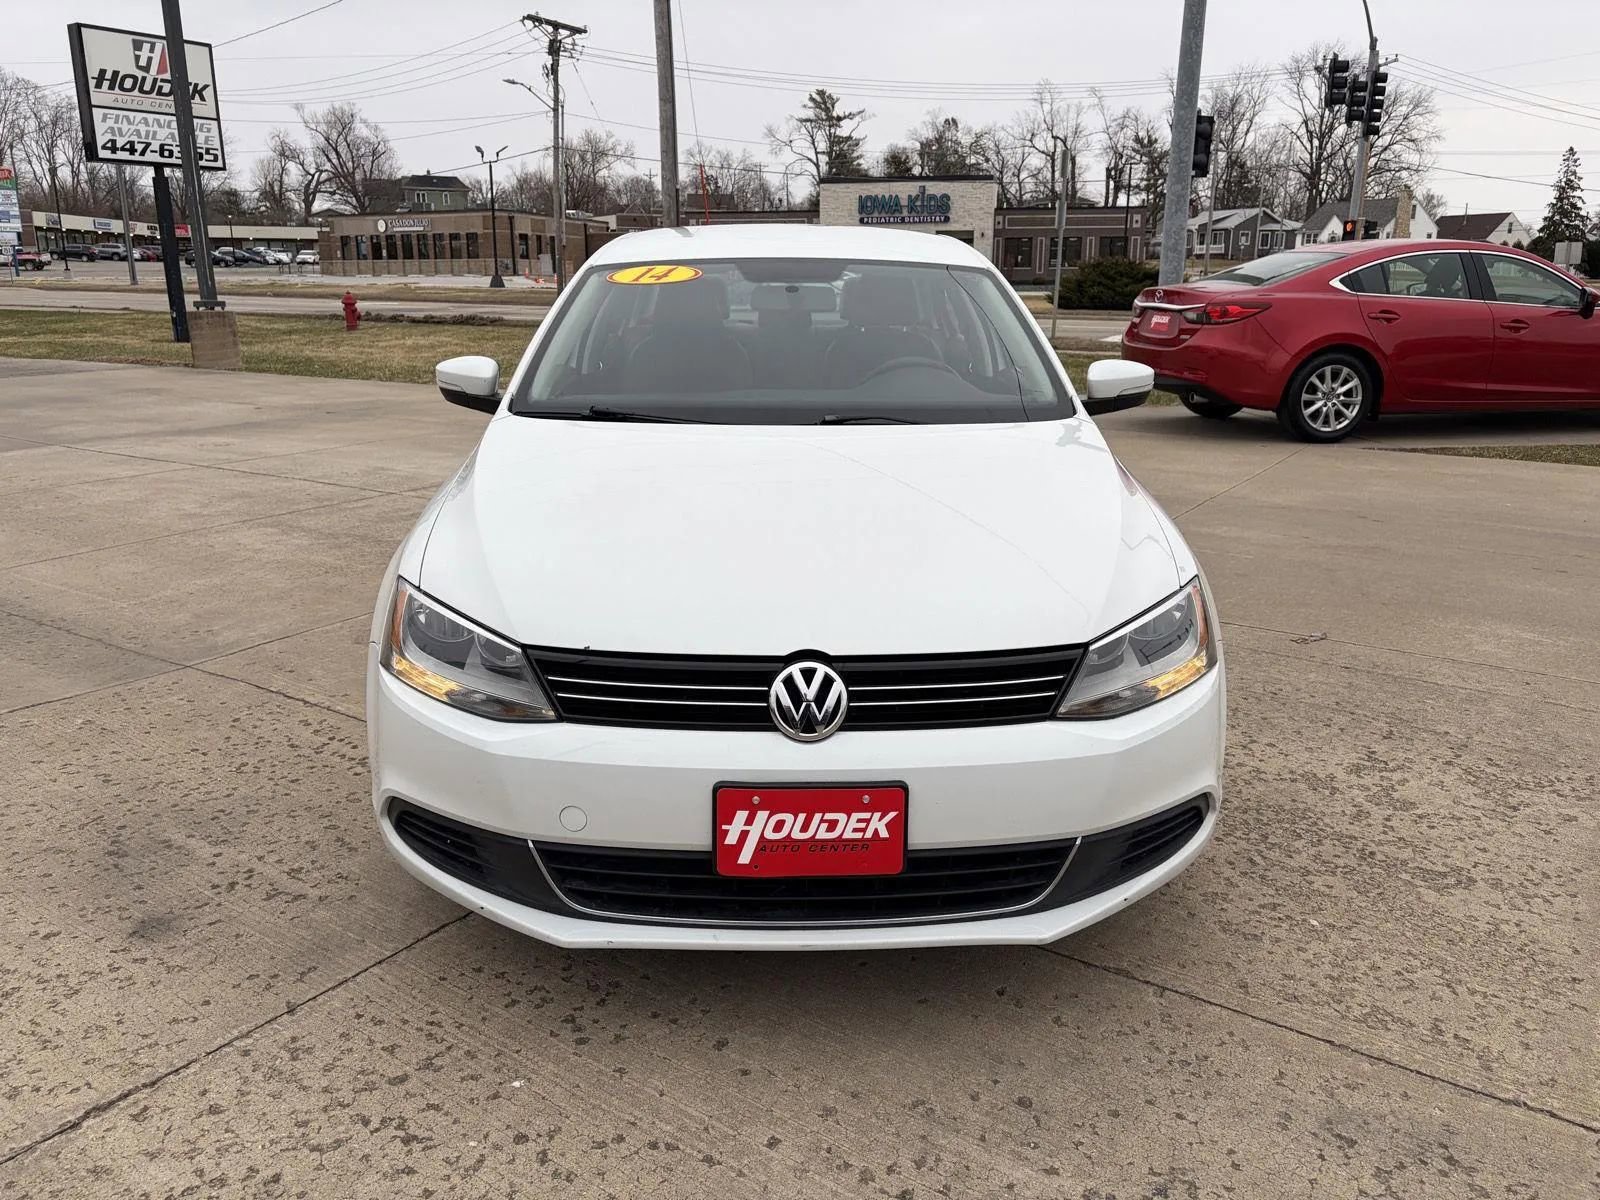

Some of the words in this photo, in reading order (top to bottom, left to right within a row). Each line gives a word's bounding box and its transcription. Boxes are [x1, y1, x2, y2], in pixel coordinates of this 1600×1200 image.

[91, 67, 211, 102] HOUDK
[113, 97, 145, 106] AUTO
[101, 111, 213, 134] FINANCG
[101, 125, 216, 147] AVAILALE
[858, 194, 902, 215] IOWA
[388, 218, 402, 227] CASA
[402, 218, 414, 227] DON
[863, 216, 902, 224] PEDIATRIC
[904, 215, 946, 223] DENTISTRY
[632, 266, 679, 282] 14
[721, 810, 899, 864] HOUDEK
[758, 843, 801, 853] AUTO
[808, 843, 870, 853] CENTER
